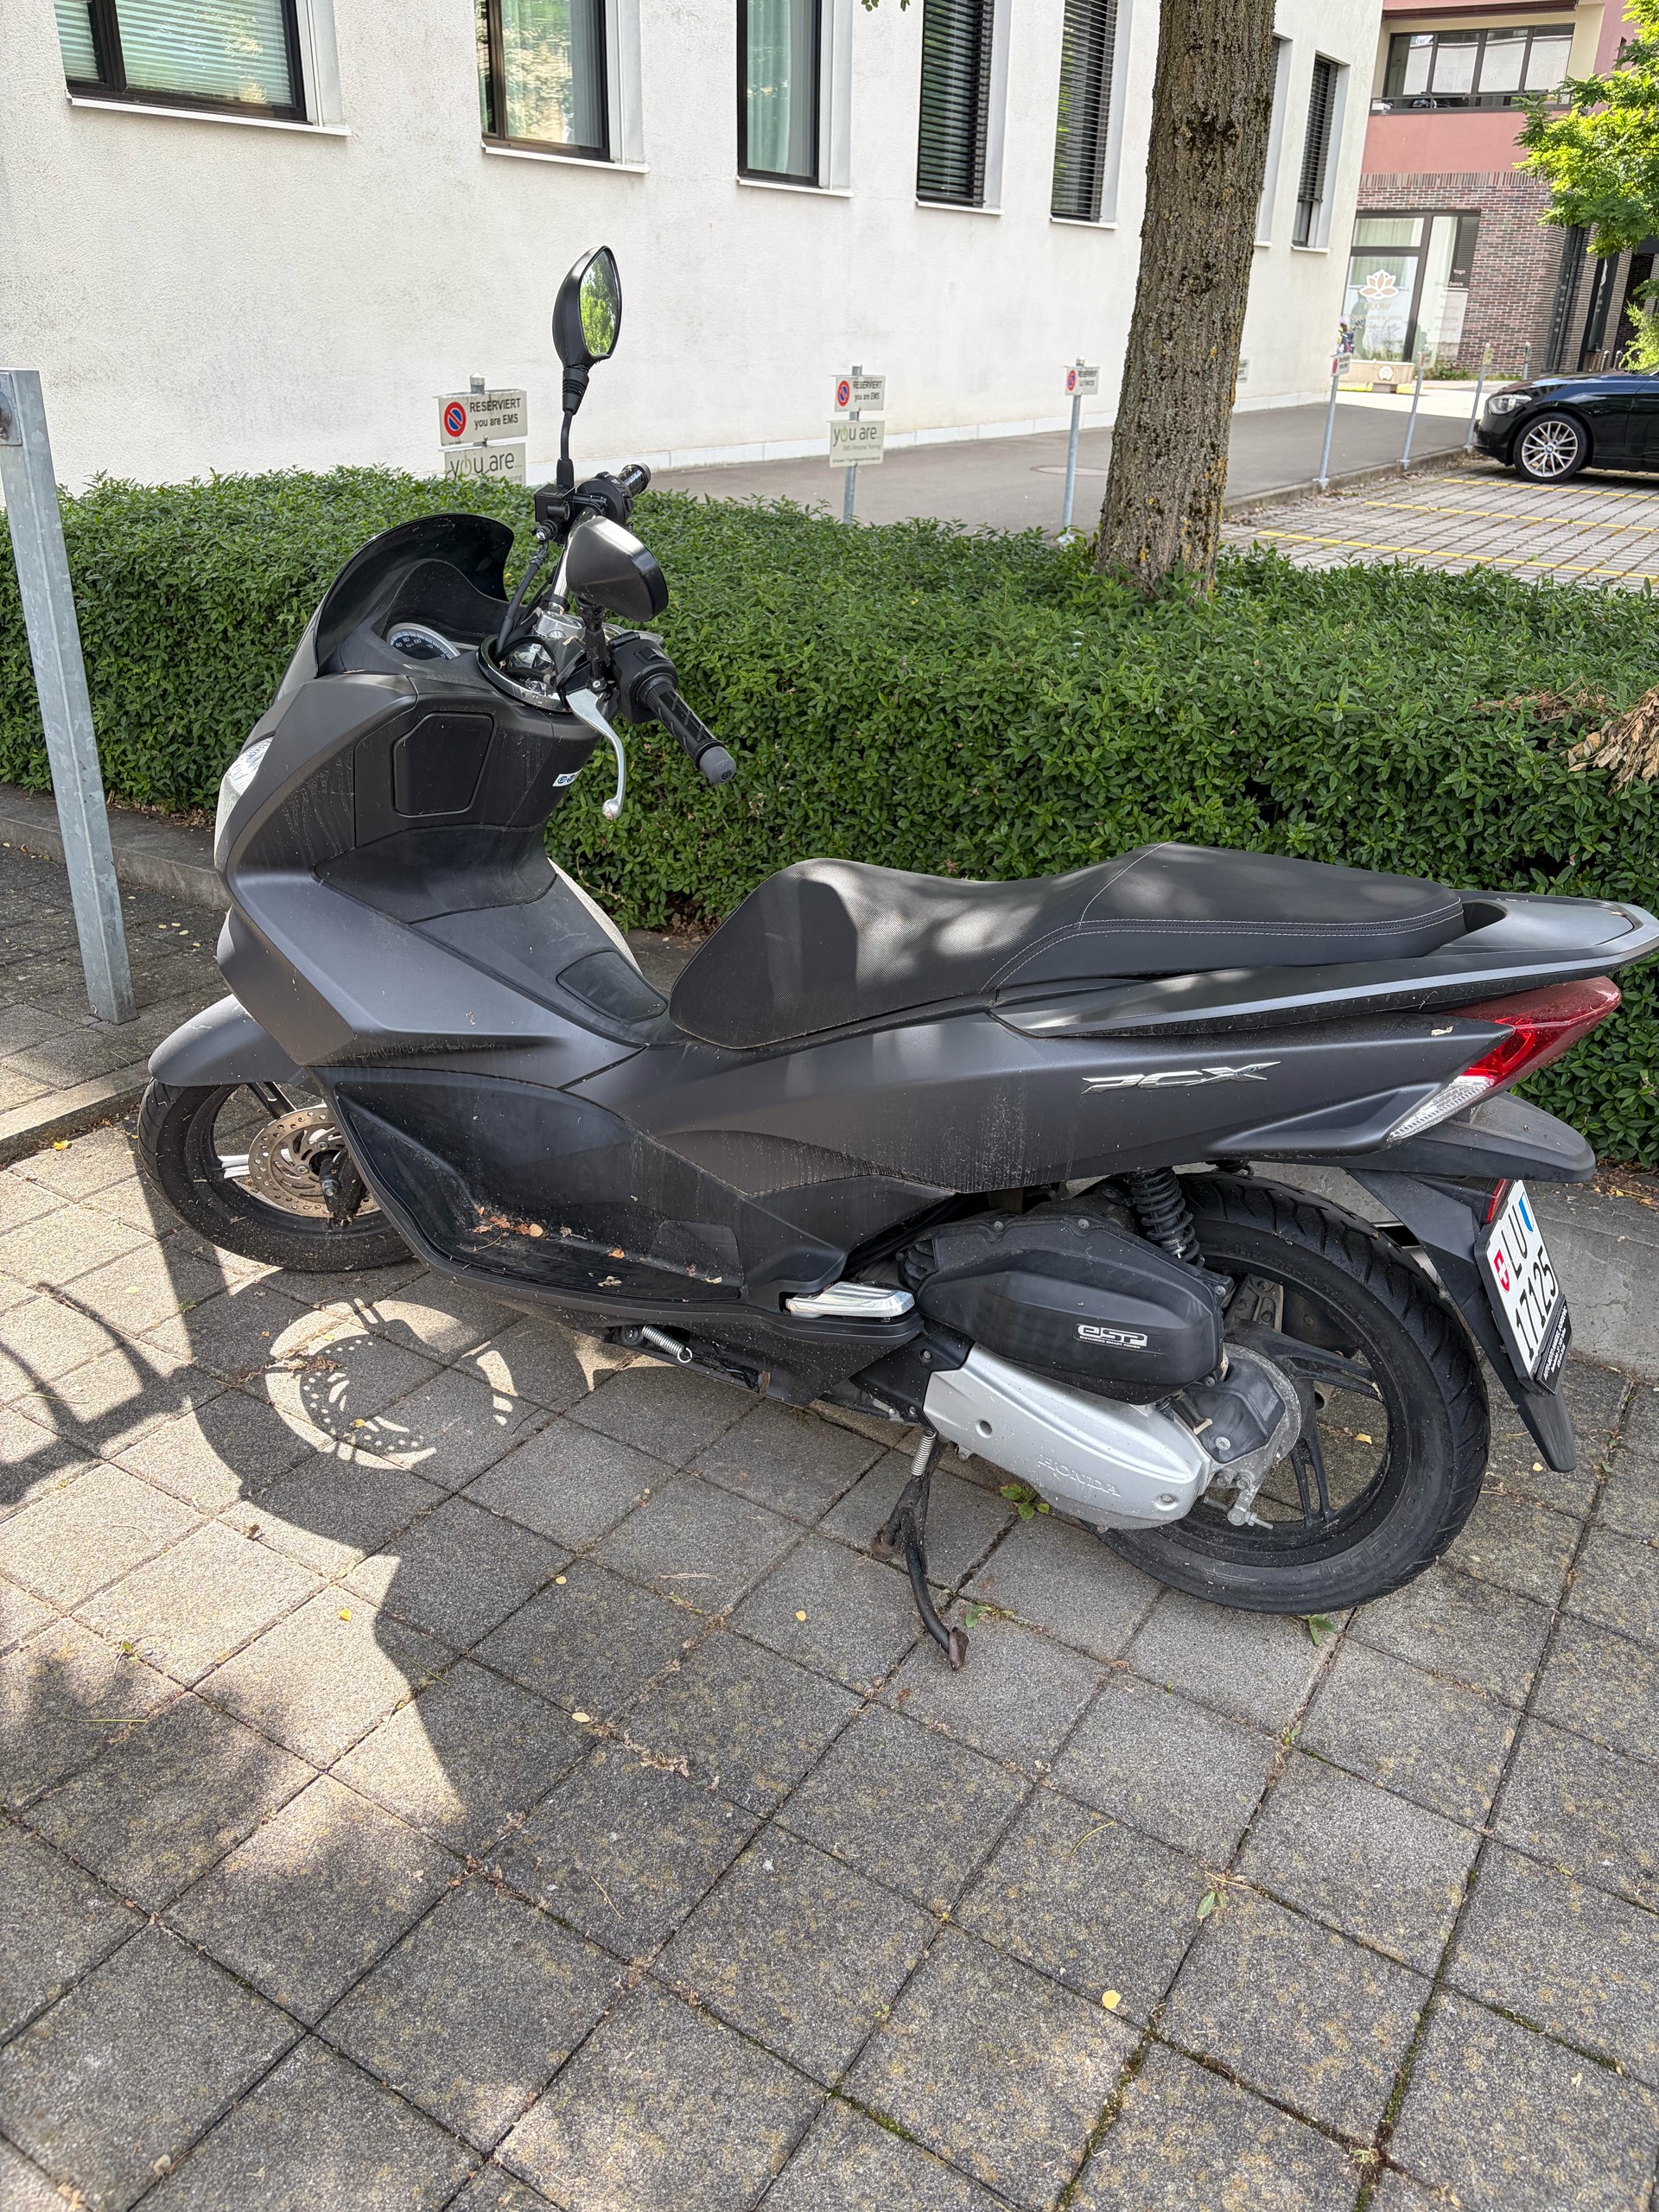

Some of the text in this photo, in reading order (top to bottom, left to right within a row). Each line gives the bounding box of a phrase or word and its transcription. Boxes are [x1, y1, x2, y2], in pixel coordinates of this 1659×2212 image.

[469, 397, 522, 413] RESERVIERT
[474, 413, 519, 430] you are EMS
[1500, 1205, 1528, 1281] LU
[1515, 1244, 1556, 1363] 17125
[1036, 1453, 1122, 1498] HONDA
